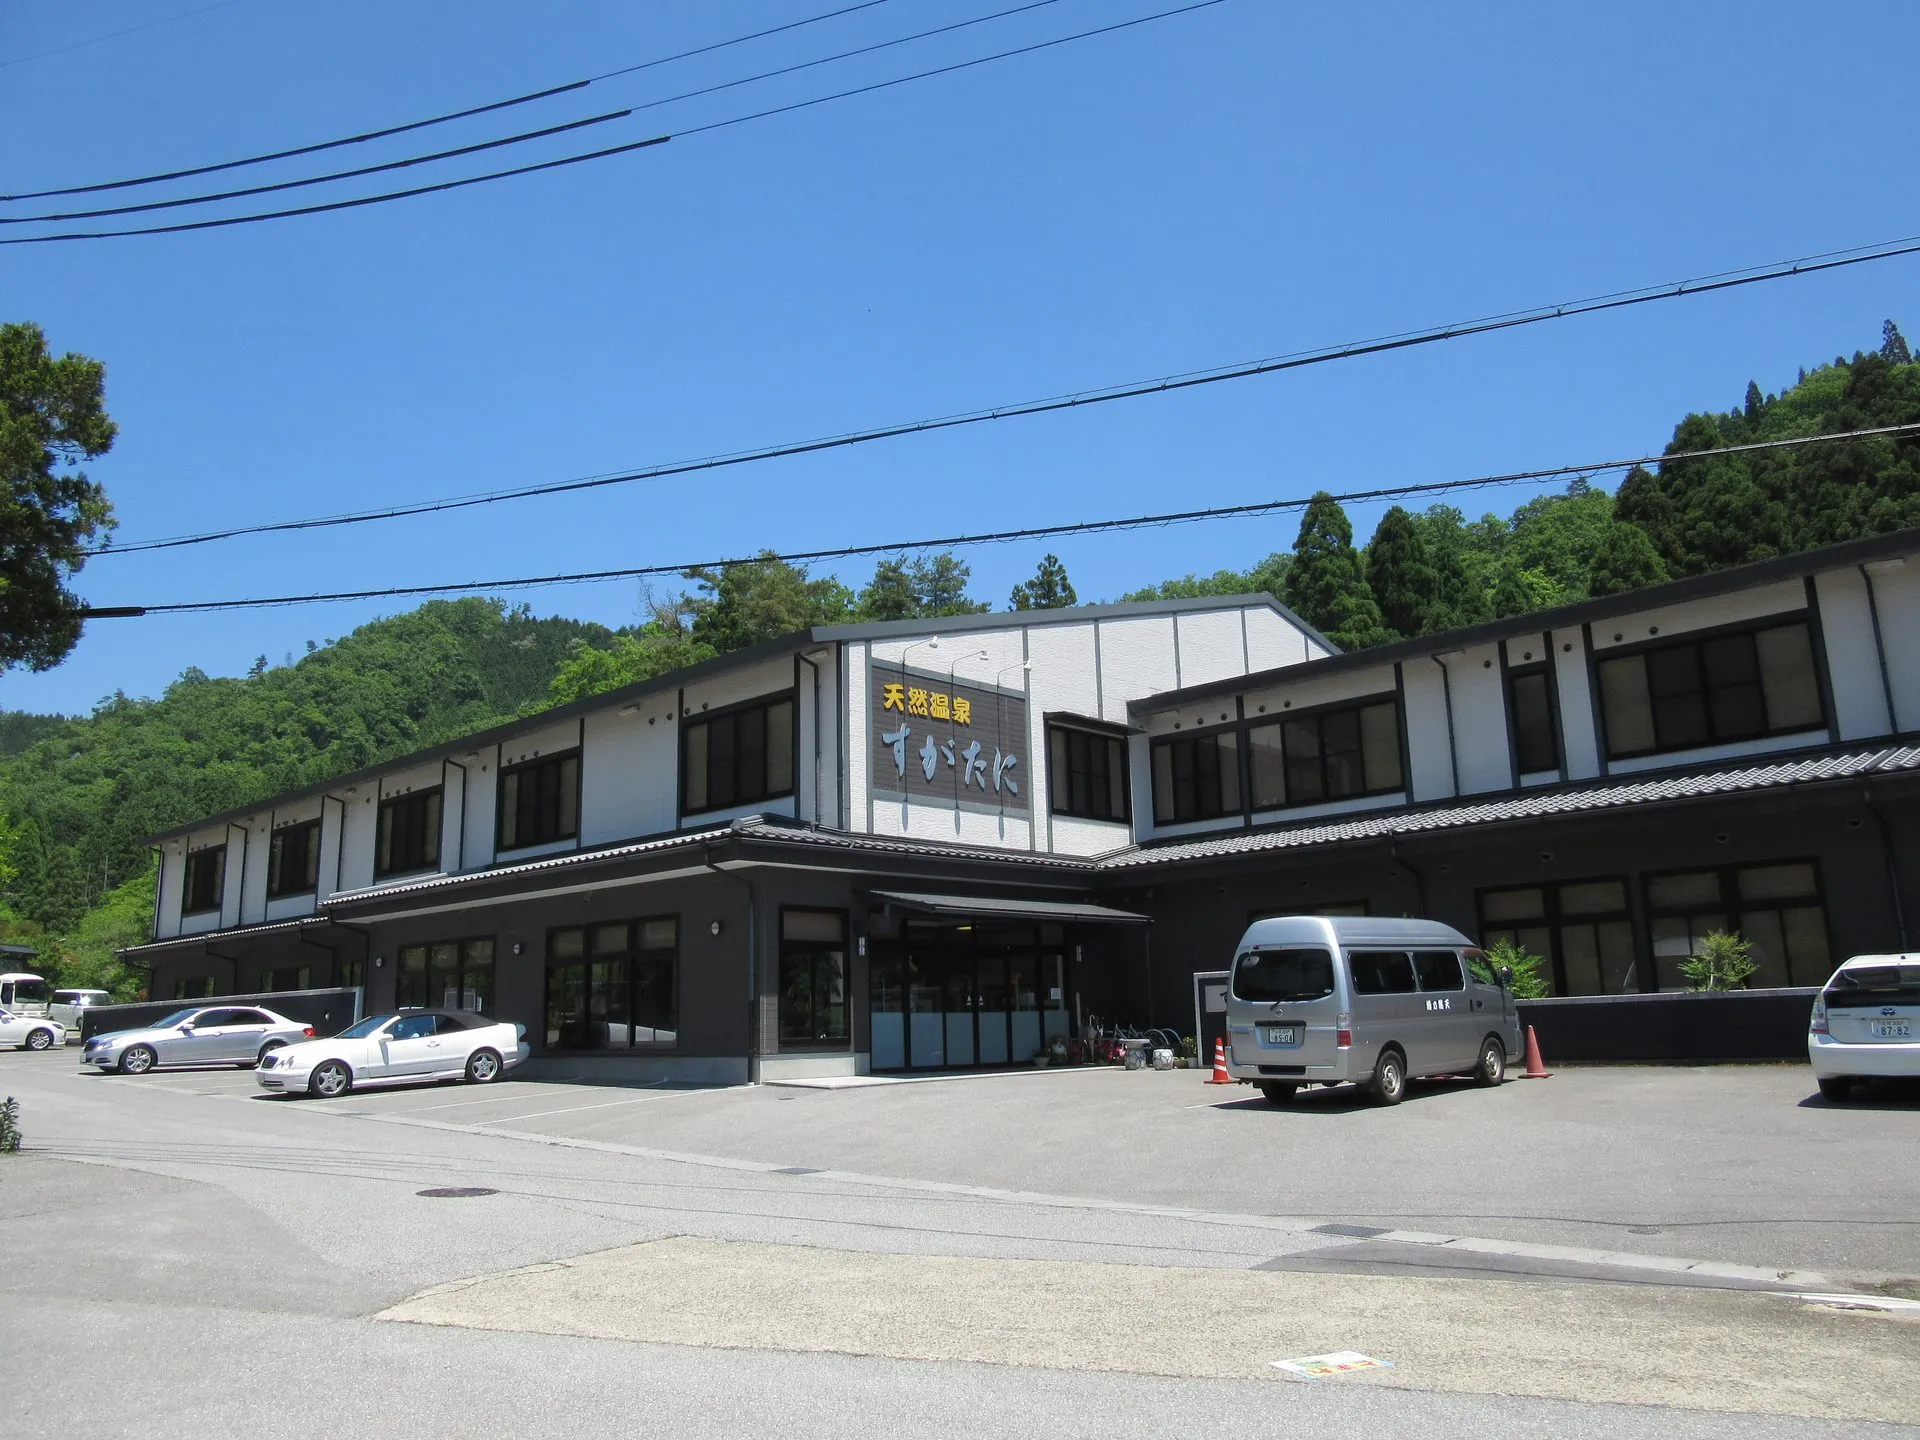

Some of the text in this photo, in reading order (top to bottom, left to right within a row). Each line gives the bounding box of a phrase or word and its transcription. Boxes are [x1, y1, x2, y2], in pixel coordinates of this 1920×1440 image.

[883, 683, 972, 725] 天然温泉
[882, 722, 1018, 795] すがたに
[1880, 1026, 1910, 1036] 87-82
